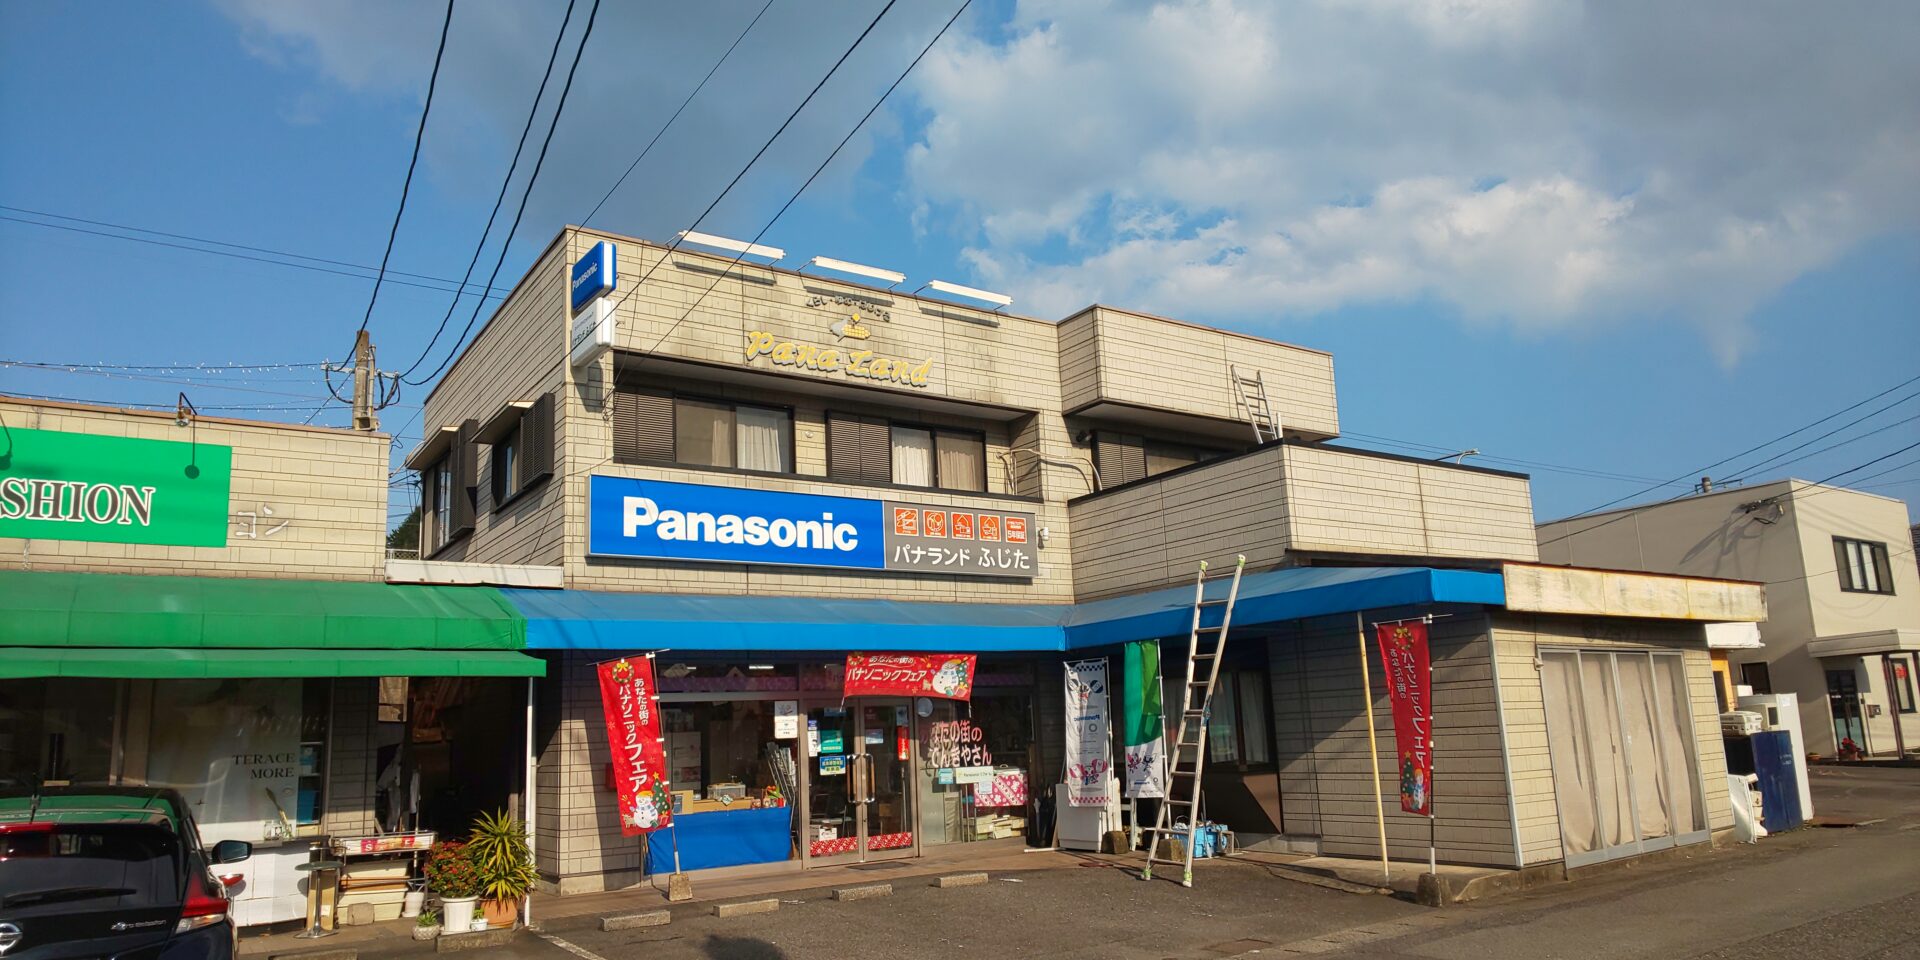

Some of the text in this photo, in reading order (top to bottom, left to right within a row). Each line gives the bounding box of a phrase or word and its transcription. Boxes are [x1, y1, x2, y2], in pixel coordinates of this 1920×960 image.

[572, 261, 598, 291] Panasonic
[746, 331, 933, 388] Pana Land
[0, 477, 156, 526] SHION
[623, 495, 858, 551] Panasonic
[894, 544, 1031, 569] パナランド ふじた
[847, 667, 927, 682] パナソニックフェア
[868, 655, 915, 664] あなたの街の
[634, 678, 649, 726] あなたの街の
[619, 684, 648, 793] パナソニックフェア
[232, 753, 295, 765] TERACE
[251, 767, 295, 779] MORE
